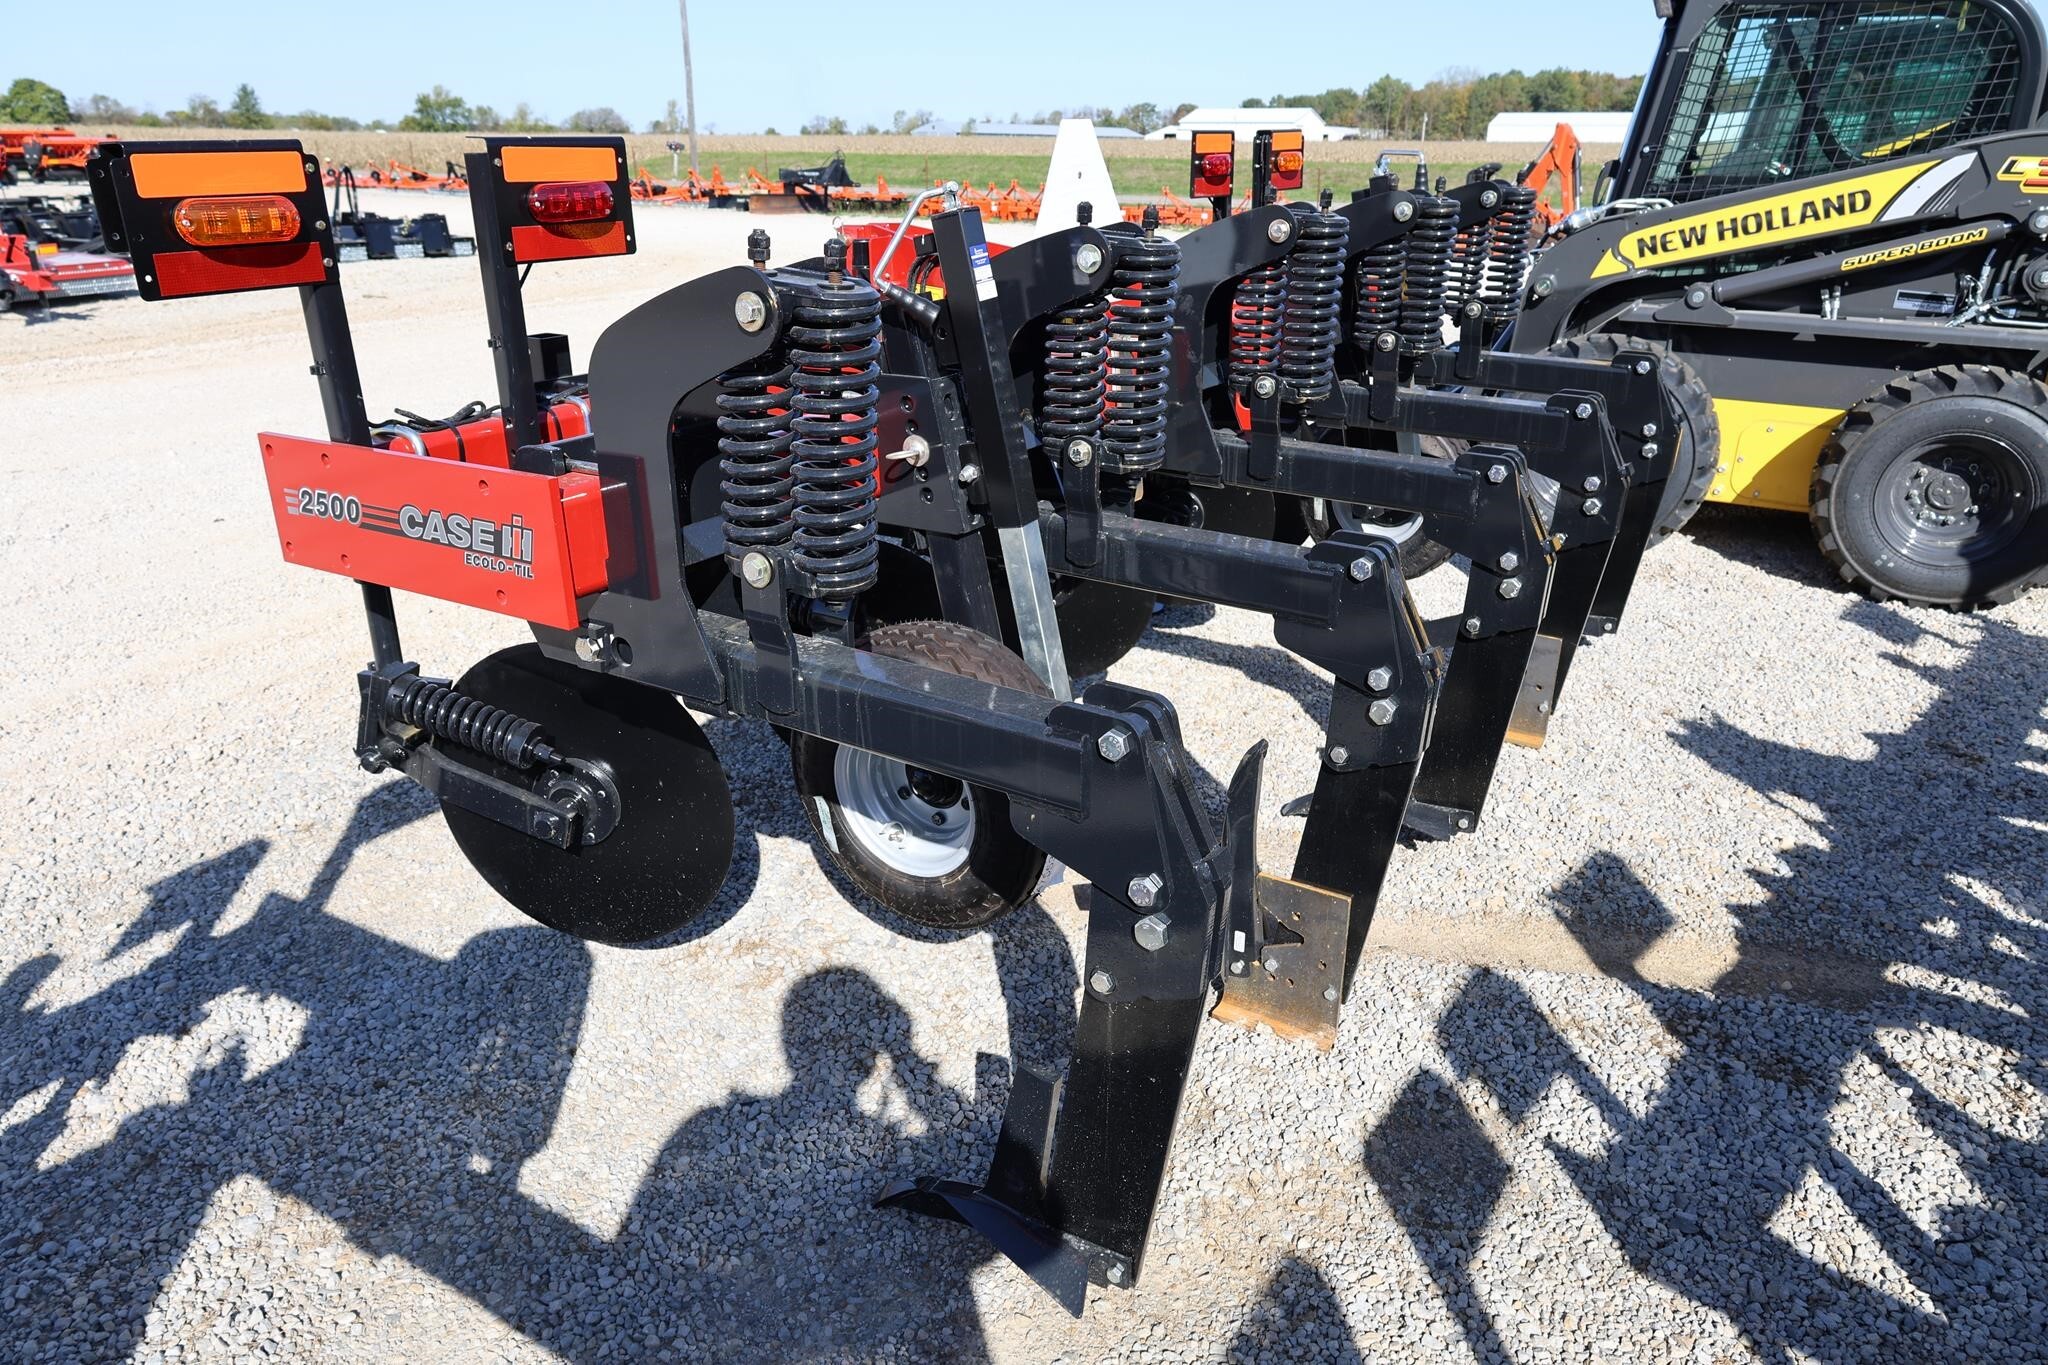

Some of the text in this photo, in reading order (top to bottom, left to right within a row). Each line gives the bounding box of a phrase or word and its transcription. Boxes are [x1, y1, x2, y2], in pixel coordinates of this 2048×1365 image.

[1637, 190, 1872, 258] NEW HOLLAND
[1842, 228, 1986, 269] SUPER BOOM
[299, 487, 361, 526] 2500
[399, 503, 496, 554] CASE
[464, 551, 535, 580] ECOLO-TIL
